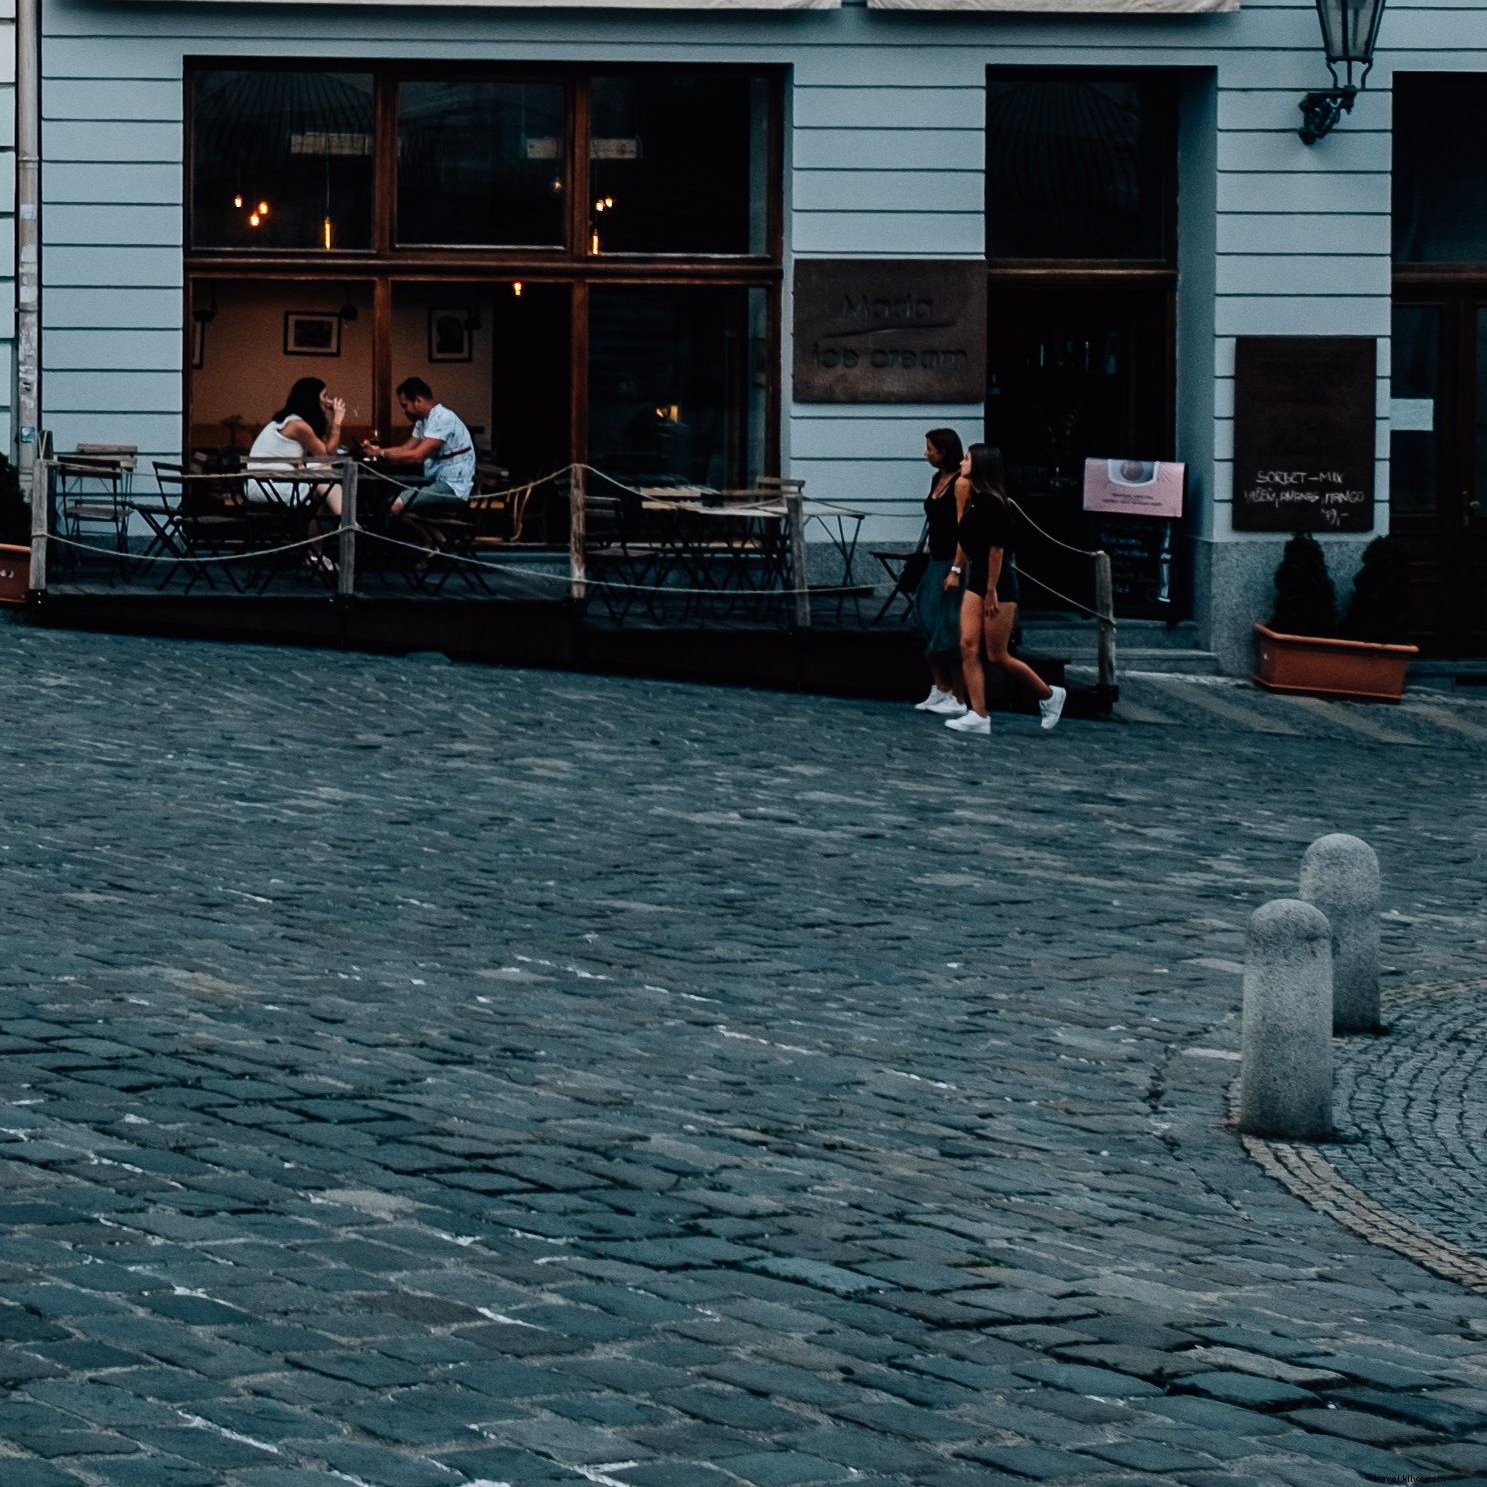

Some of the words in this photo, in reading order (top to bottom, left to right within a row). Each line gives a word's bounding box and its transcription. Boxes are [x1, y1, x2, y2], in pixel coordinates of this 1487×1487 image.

[843, 293, 933, 322] Mada
[812, 341, 860, 369] ice
[870, 348, 968, 369] cream
